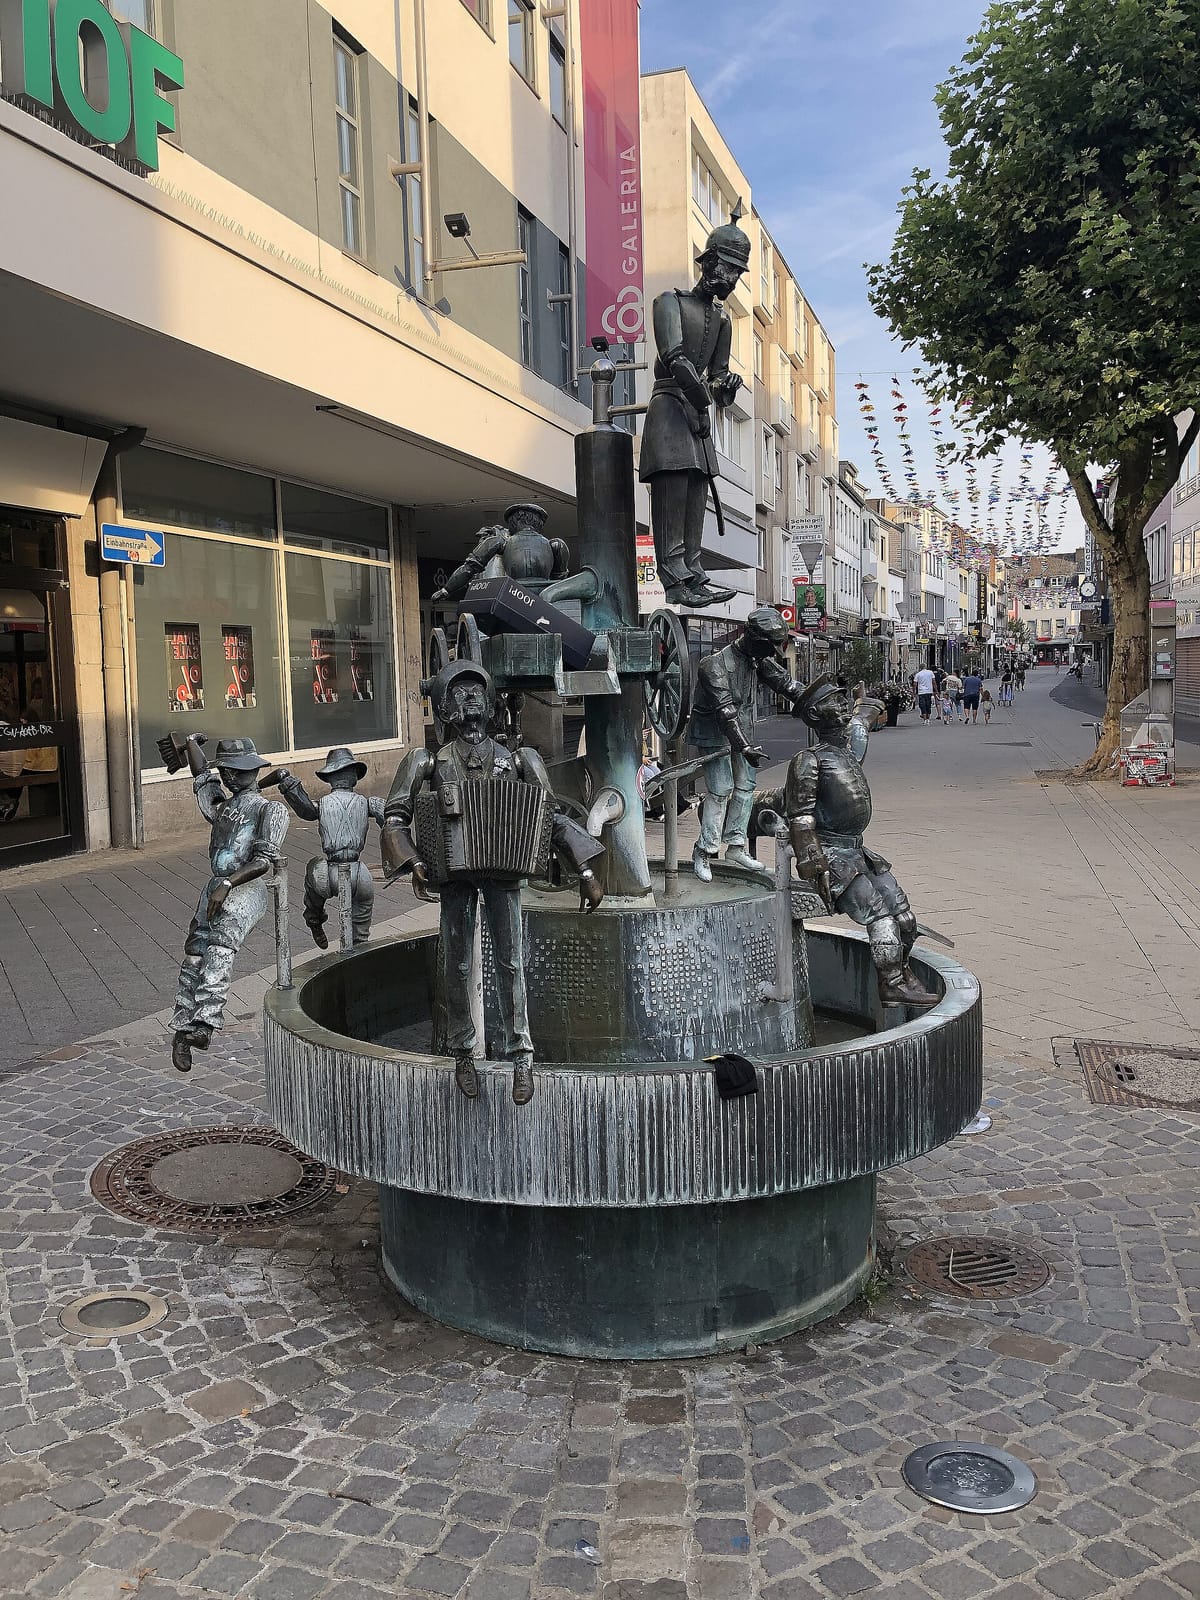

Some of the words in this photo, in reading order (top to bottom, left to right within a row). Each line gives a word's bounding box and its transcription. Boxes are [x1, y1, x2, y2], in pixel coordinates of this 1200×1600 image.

[620, 145, 638, 275] GALERIA
[106, 537, 148, 550] Einbahnstraße
[508, 584, 535, 607] JOOP!
